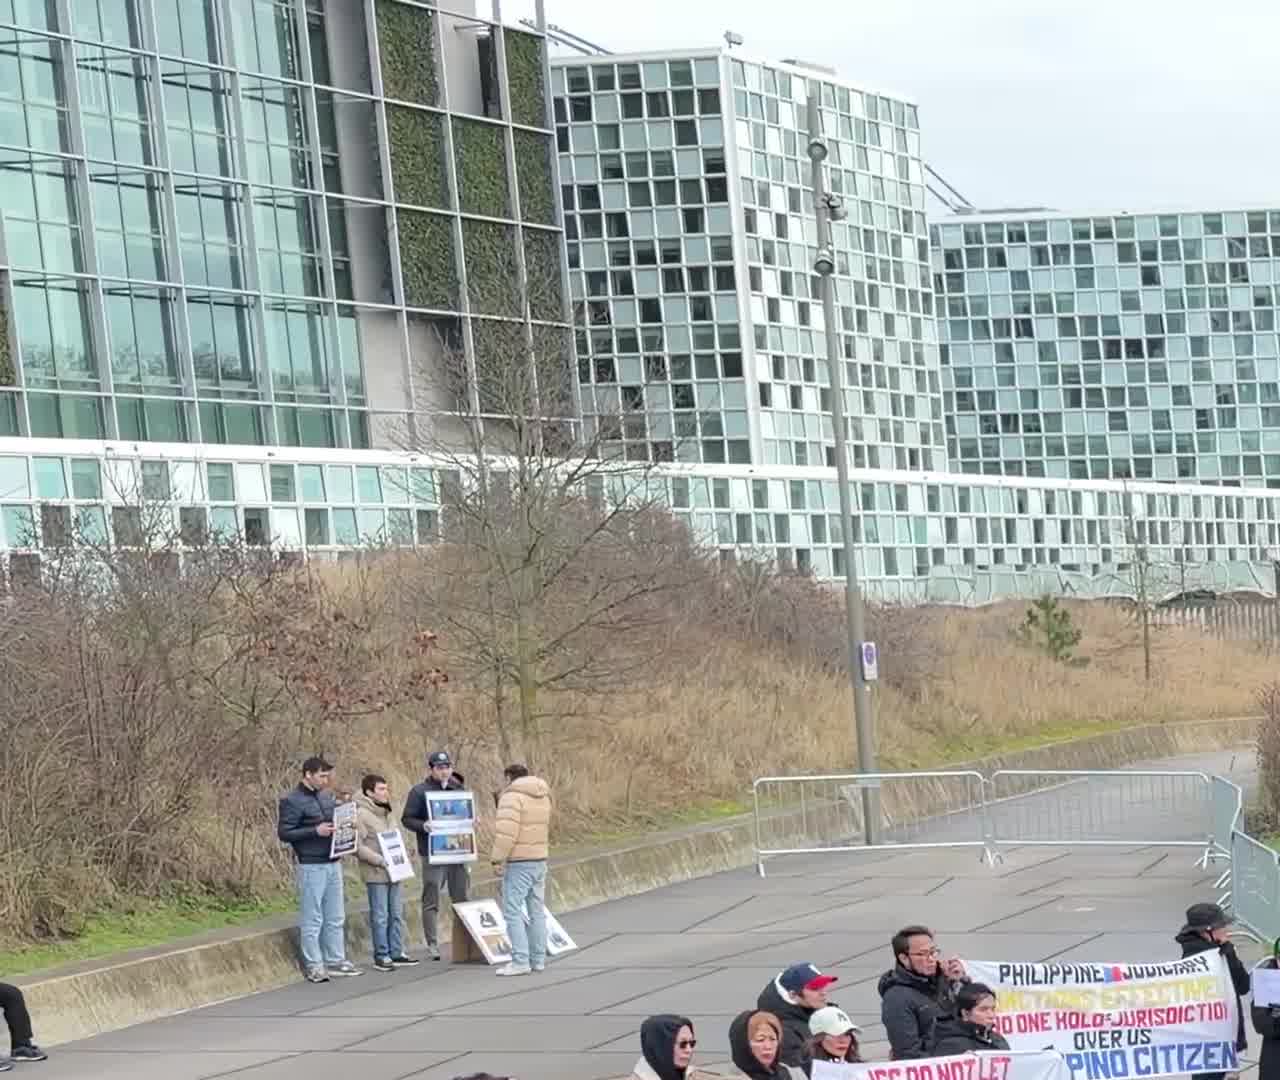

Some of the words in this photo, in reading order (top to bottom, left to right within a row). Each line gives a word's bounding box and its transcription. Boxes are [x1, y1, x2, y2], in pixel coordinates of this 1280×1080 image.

[1000, 963, 1104, 985] PHILIPPINE
[1016, 1012, 1052, 1033] ONE
[1073, 1030, 1122, 1050] OVER
[1127, 1028, 1151, 1046] US
[1135, 1041, 1239, 1077] CITIZEN
